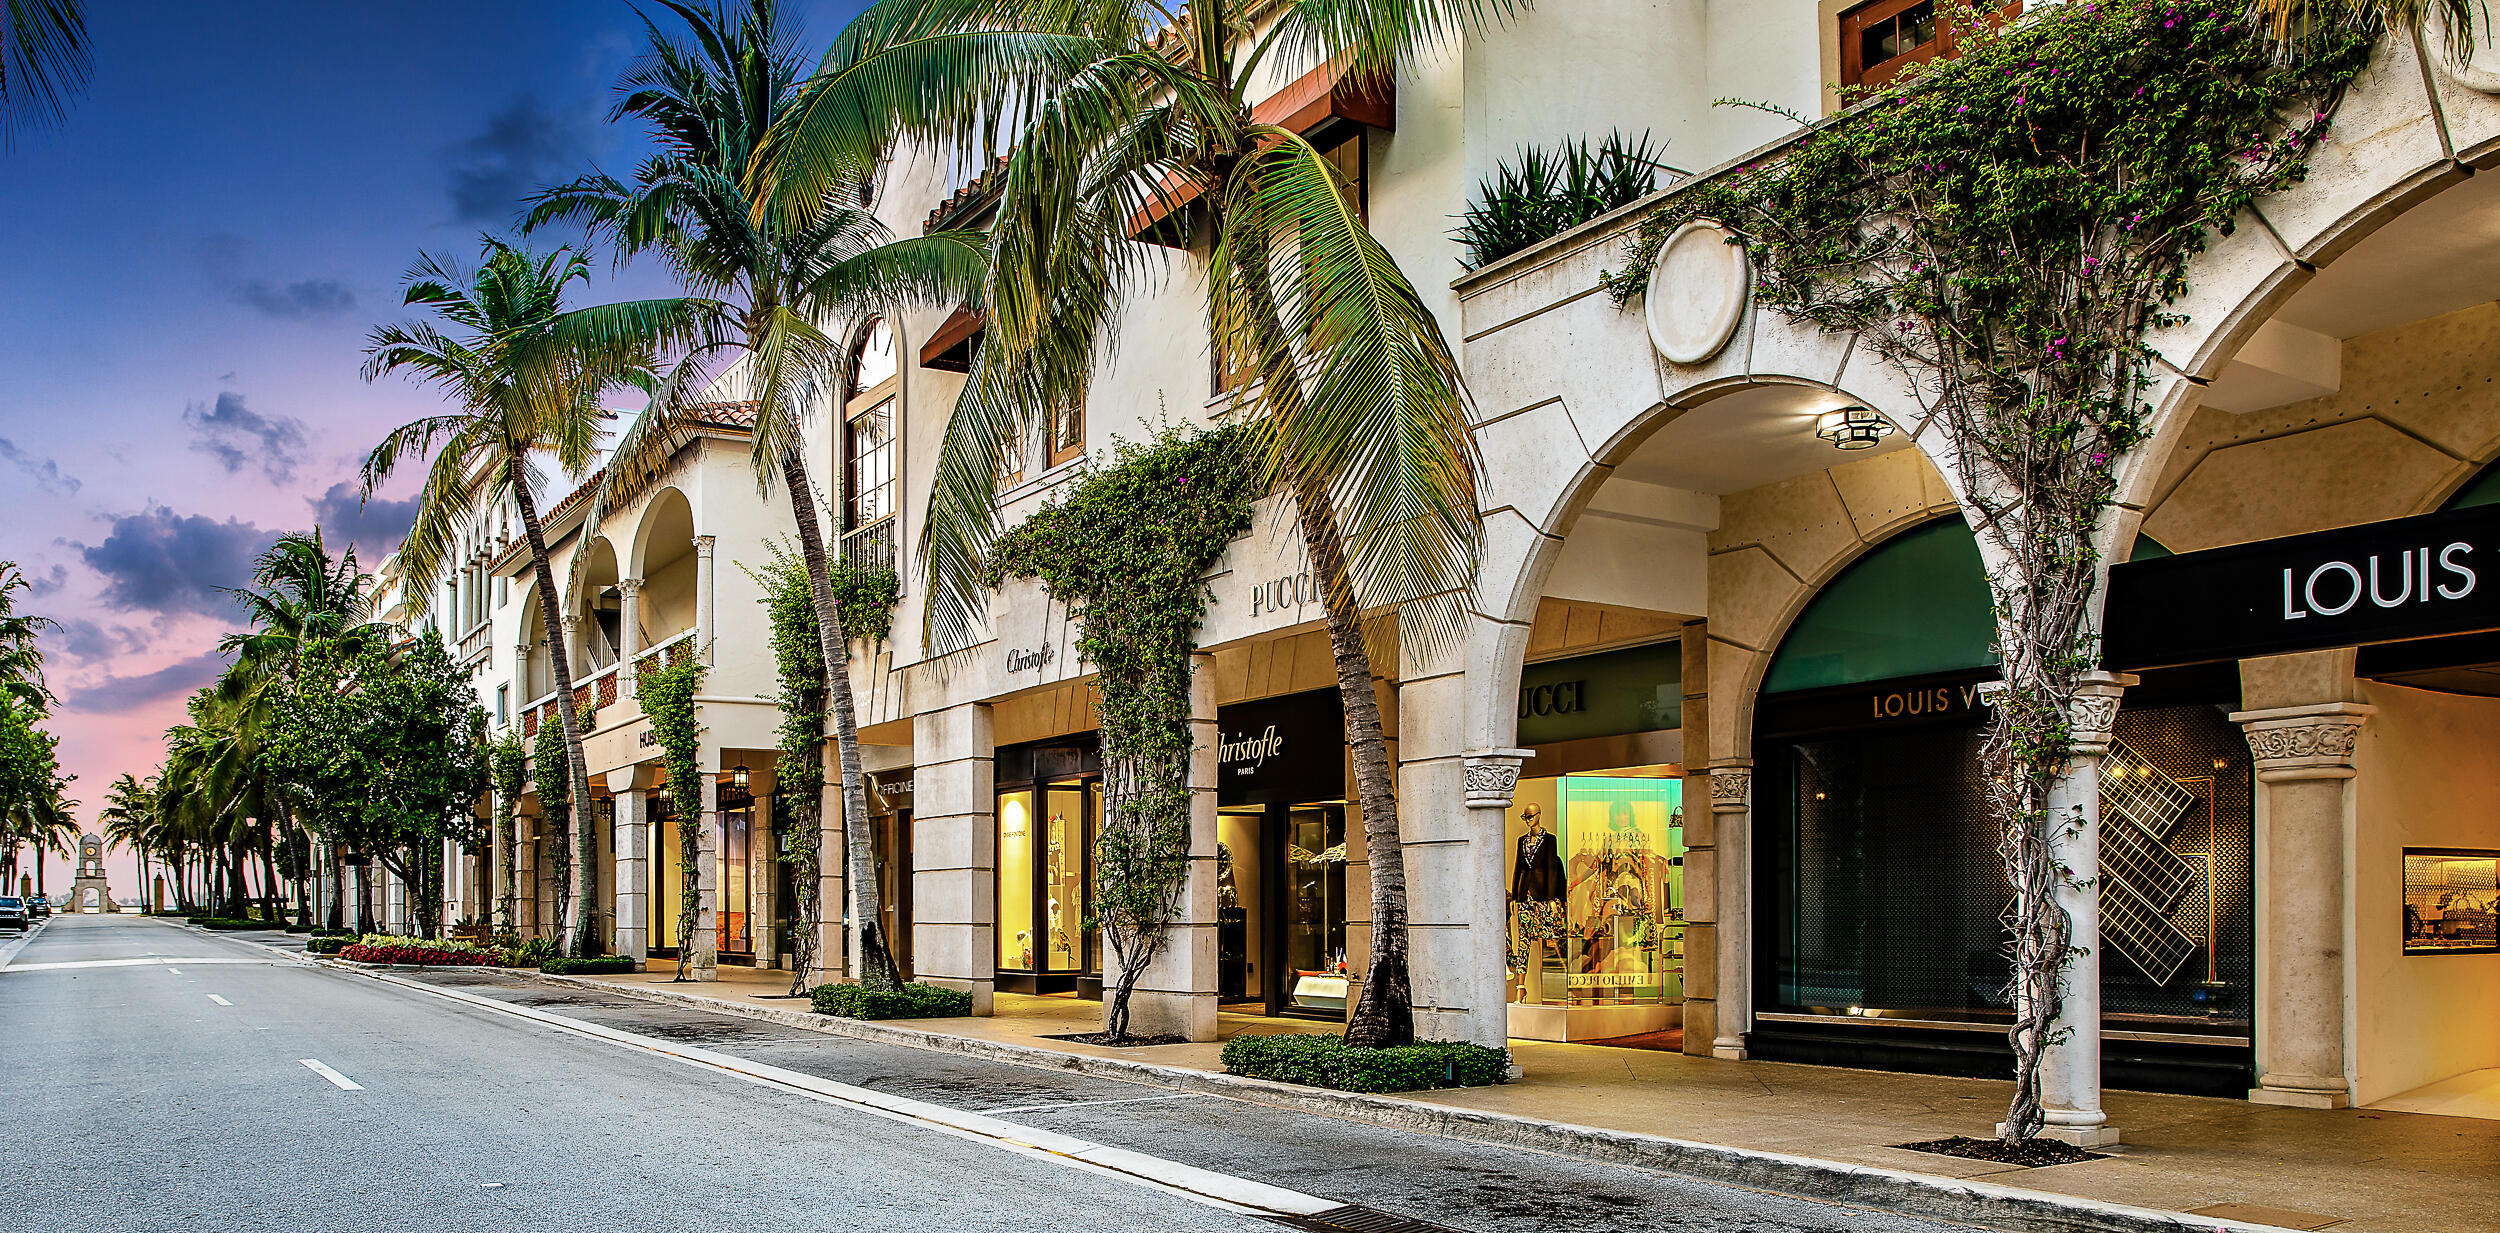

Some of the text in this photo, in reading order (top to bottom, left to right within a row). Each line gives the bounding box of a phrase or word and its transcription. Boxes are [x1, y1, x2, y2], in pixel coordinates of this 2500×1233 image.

[1248, 570, 1318, 617] PUCCI
[2284, 542, 2476, 620] LOUIS
[1006, 641, 1055, 674] Christofle
[1518, 680, 1586, 719] UCCI
[1874, 688, 1949, 718] LOUIS
[1217, 725, 1283, 767] hristofle
[878, 779, 914, 796] OFFICINE
[1237, 766, 1255, 776] PARIS
